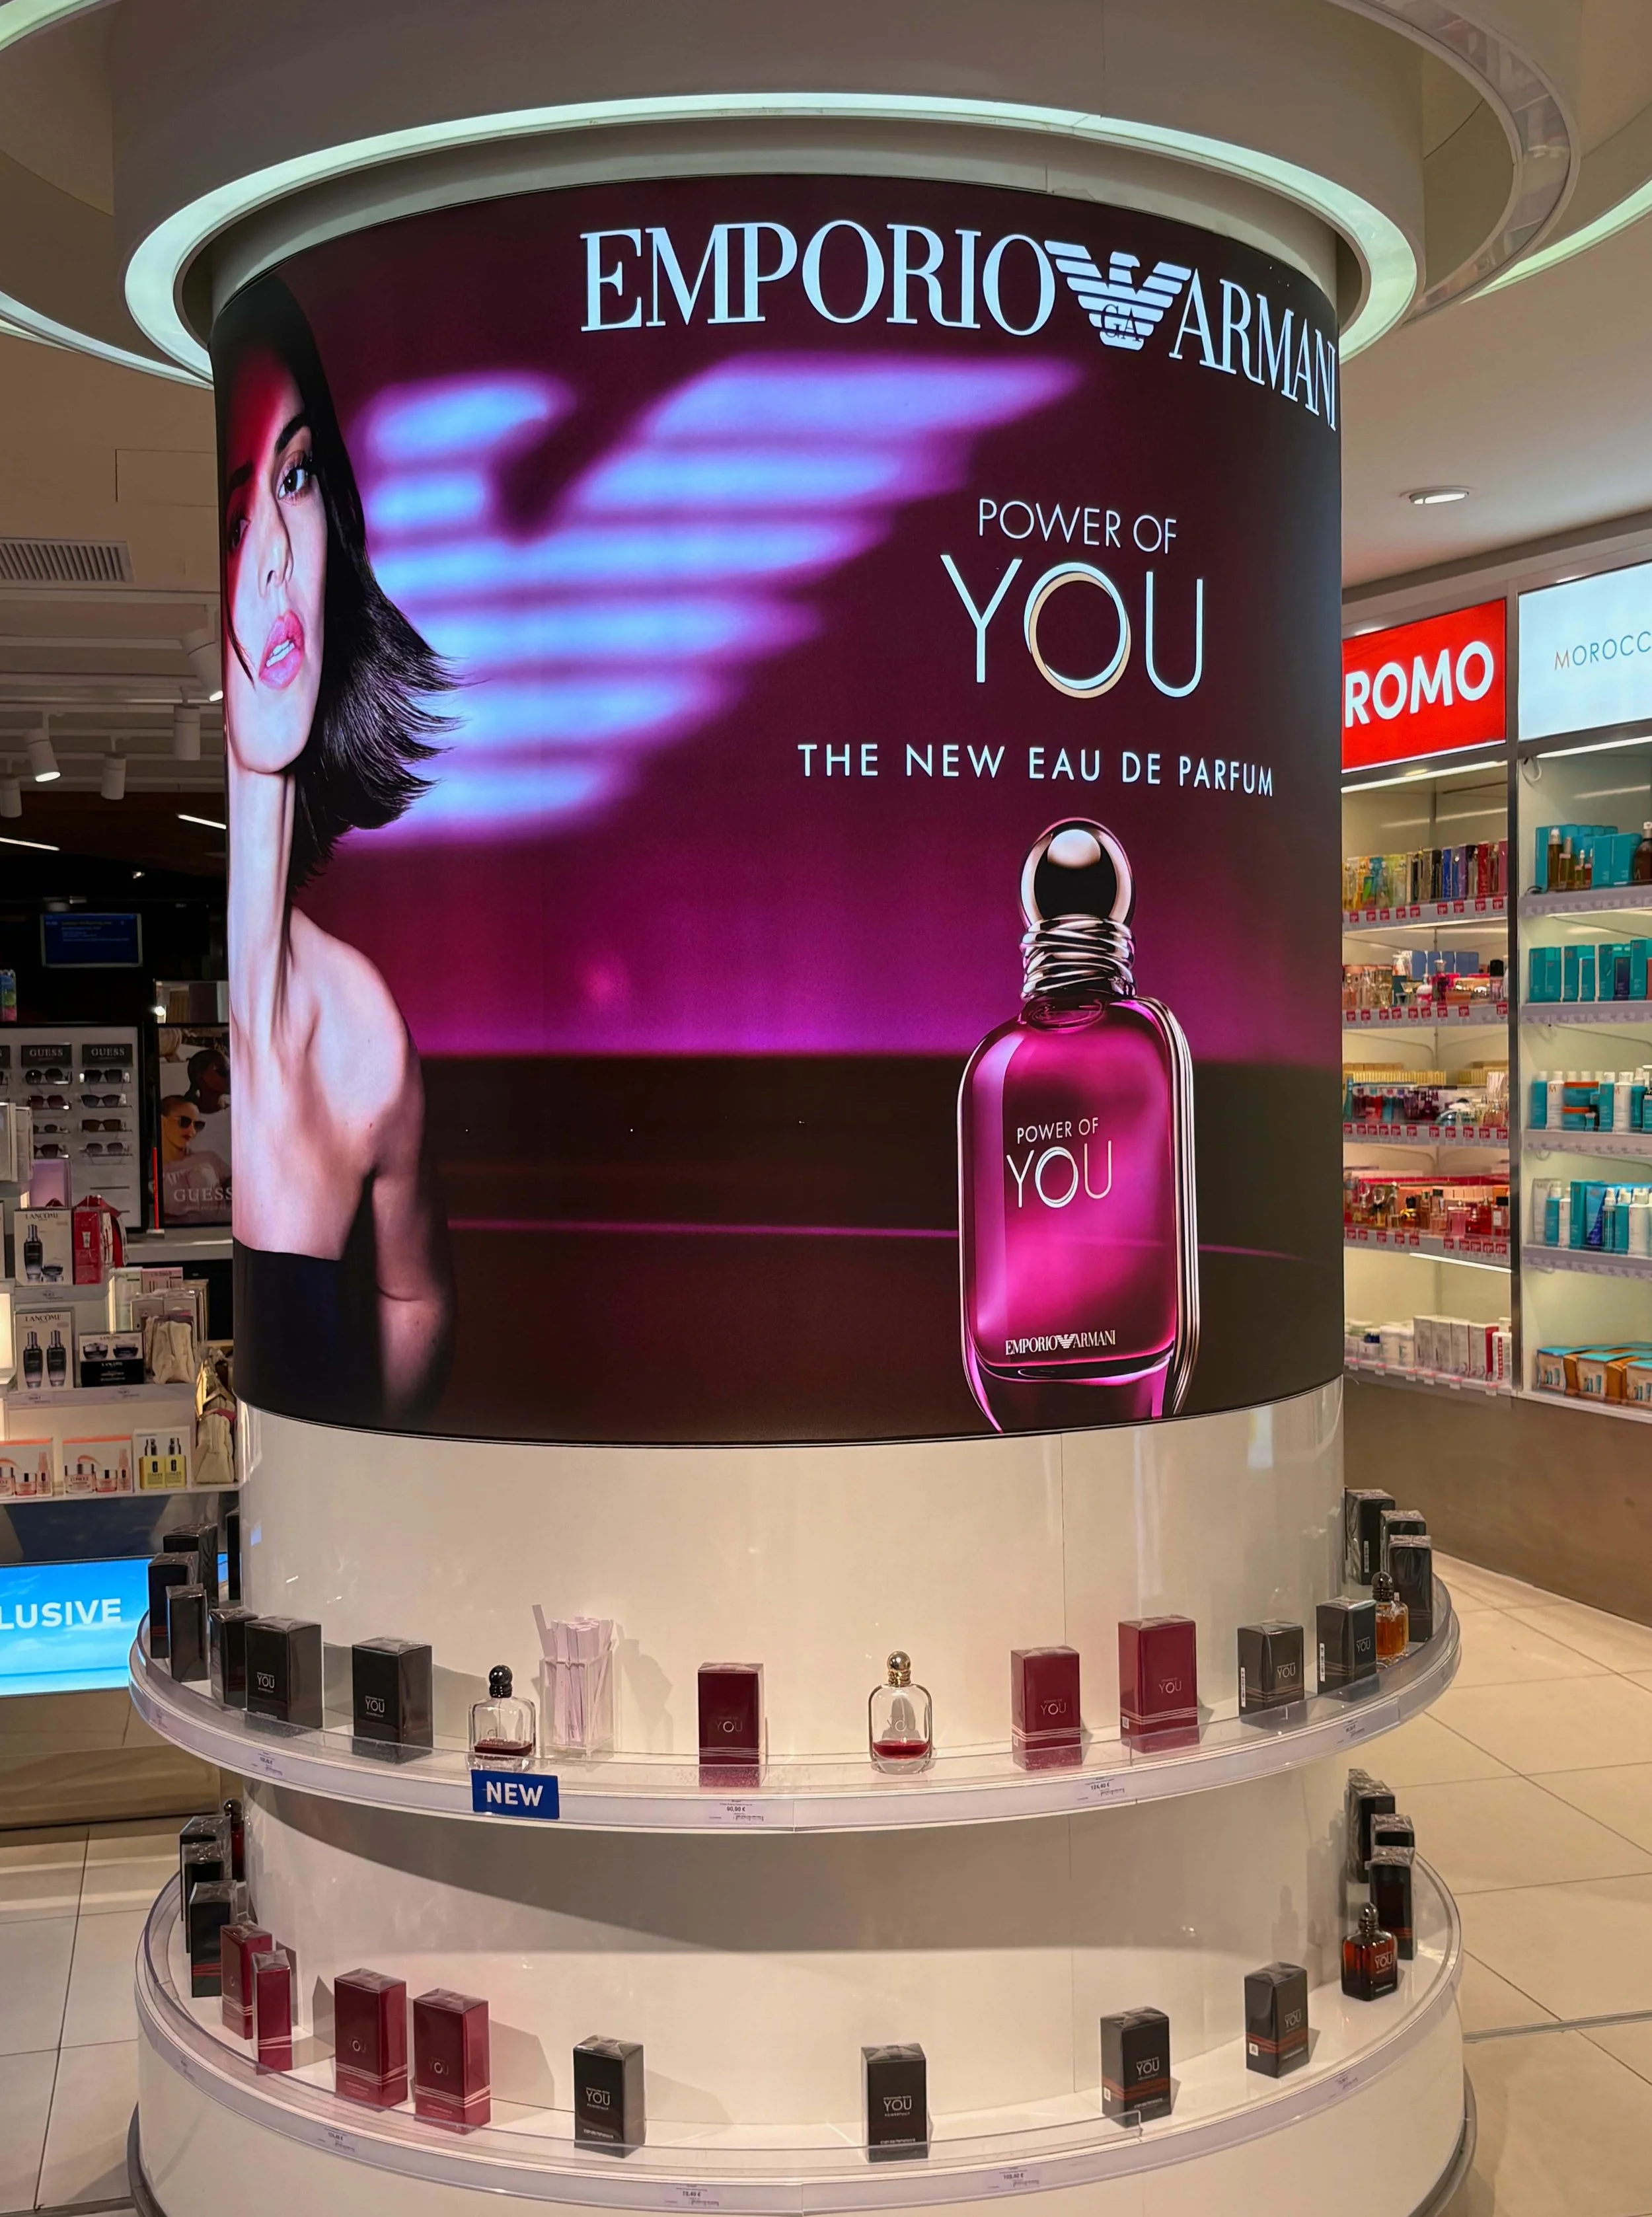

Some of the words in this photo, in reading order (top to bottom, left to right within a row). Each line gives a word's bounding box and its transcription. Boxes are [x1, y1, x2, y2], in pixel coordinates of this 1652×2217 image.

[580, 220, 1058, 337] EMPORIO
[1169, 268, 1336, 431] ARMANI
[979, 498, 1121, 548] POWER
[1133, 514, 1178, 554] OF
[940, 554, 1203, 699] YOU
[1554, 630, 1651, 671] MOROCC
[1345, 640, 1494, 728] ROMO
[798, 743, 879, 777] THE
[906, 744, 1005, 779] NEW
[1029, 747, 1102, 782] EAU
[1122, 752, 1160, 786] DE
[1180, 757, 1273, 797] PARFUM
[29, 1048, 63, 1057] GUESS
[91, 1047, 125, 1057] GUESS
[1017, 1120, 1072, 1144] POWER
[1078, 1117, 1098, 1135] OF
[1006, 1140, 1112, 1209] YOU
[174, 1187, 232, 1203] GUESS
[1005, 1335, 1057, 1355] EMPORIO
[1073, 1330, 1115, 1348] ARMANI
[1356, 1638, 1370, 1653] YOU
[1277, 1663, 1296, 1678] YOU
[257, 1674, 276, 1689] YOU
[1158, 1680, 1182, 1694] YOU
[365, 1698, 385, 1713] YOU
[1040, 1702, 1067, 1716] YOU
[716, 1721, 743, 1733] YOU
[486, 1781, 544, 1807] NEW
[1374, 1953, 1392, 1969] YOU
[1285, 2010, 1301, 2028] YOU
[1136, 2059, 1160, 2076] YOU
[585, 2089, 611, 2106] YOU
[883, 2098, 912, 2112] YOU
